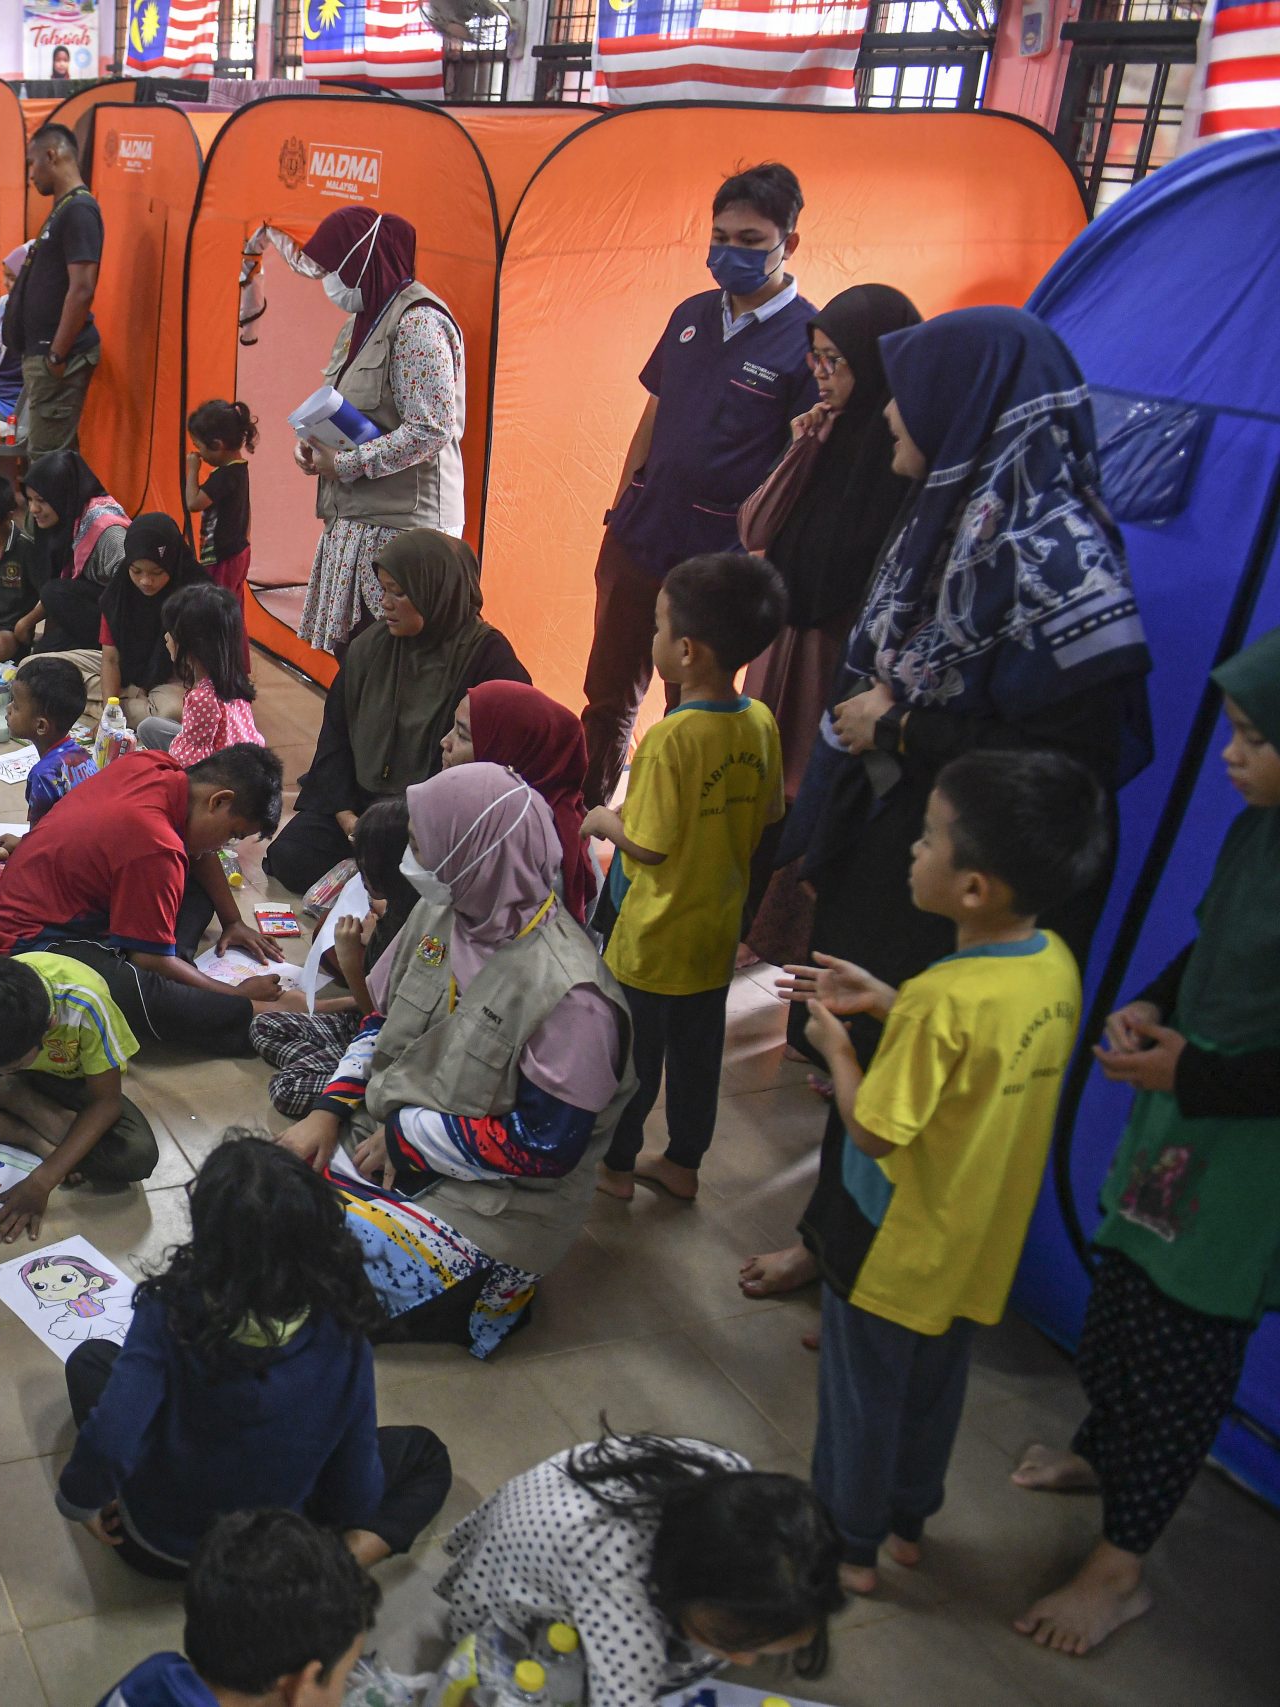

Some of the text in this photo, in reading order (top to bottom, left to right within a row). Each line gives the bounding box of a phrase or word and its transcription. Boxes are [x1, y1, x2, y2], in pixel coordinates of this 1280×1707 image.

[30, 24, 92, 48] Tahniah
[120, 139, 153, 161] NADMA
[309, 151, 379, 185] NADMA
[325, 179, 359, 194] MALAYSIA
